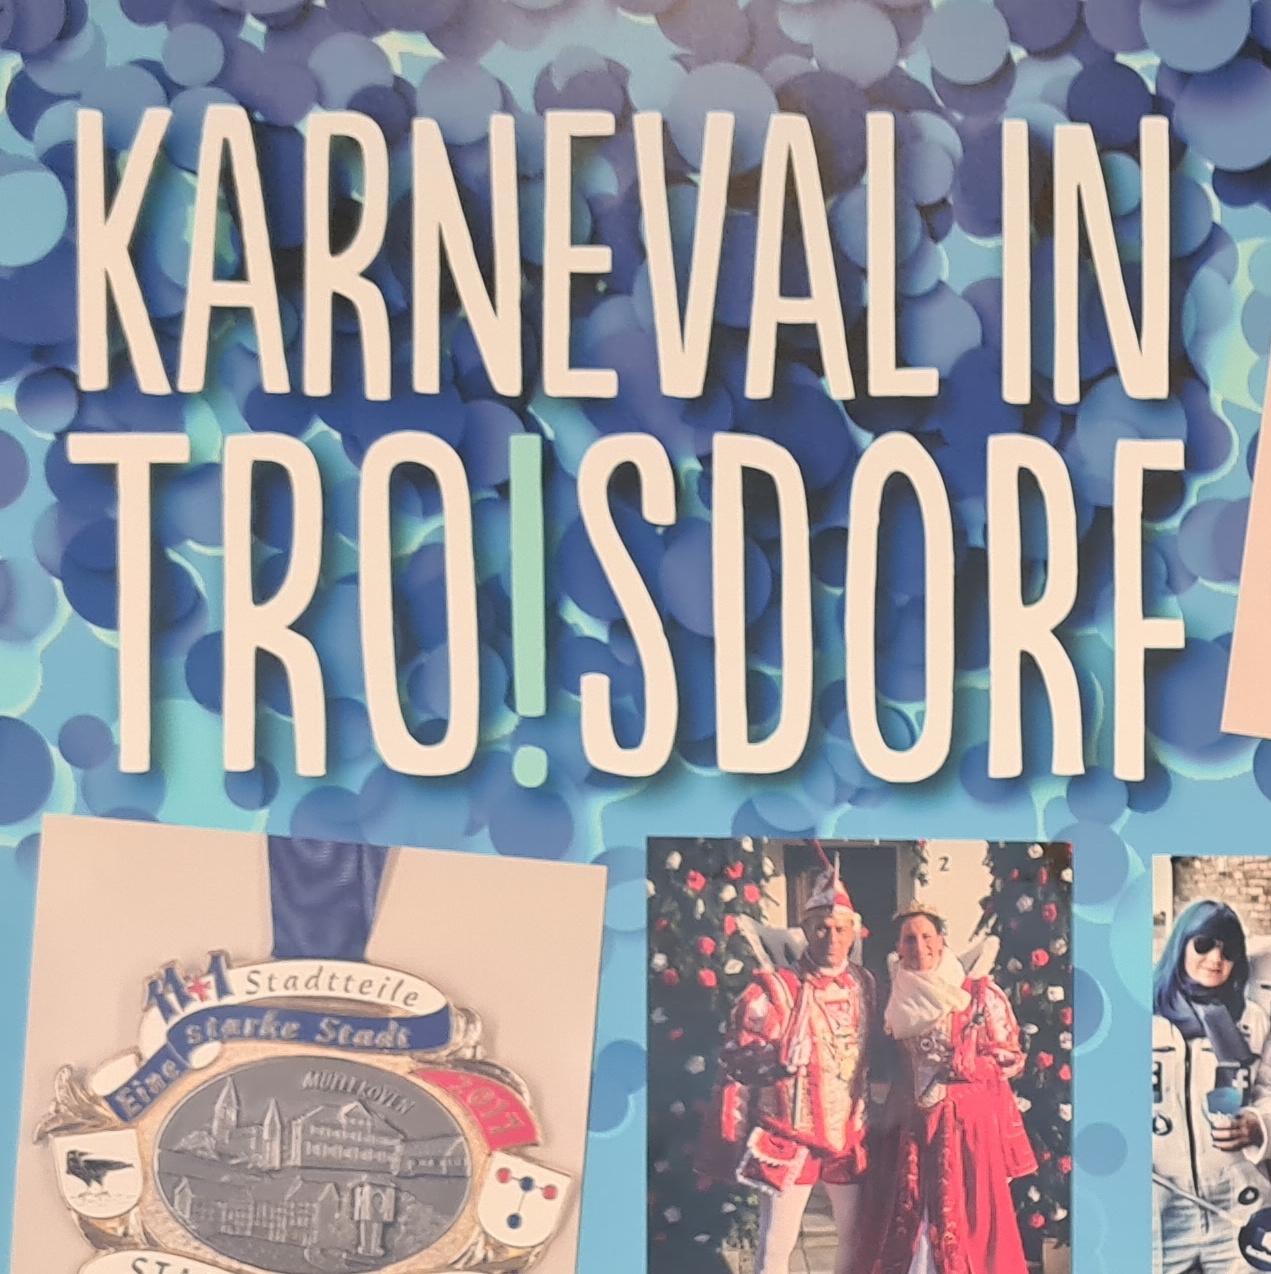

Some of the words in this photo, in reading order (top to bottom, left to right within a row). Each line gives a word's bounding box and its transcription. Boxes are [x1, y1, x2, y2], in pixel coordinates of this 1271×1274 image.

[75, 103, 940, 401] KARNEVAL
[1001, 114, 1171, 405] IN
[66, 429, 1187, 788] TRO!SDORF
[245, 966, 420, 1008] Stadtteile
[116, 1058, 183, 1117] Eine
[185, 1010, 301, 1046] starke
[315, 1016, 412, 1051] Stadt
[448, 1076, 523, 1135] 2017
